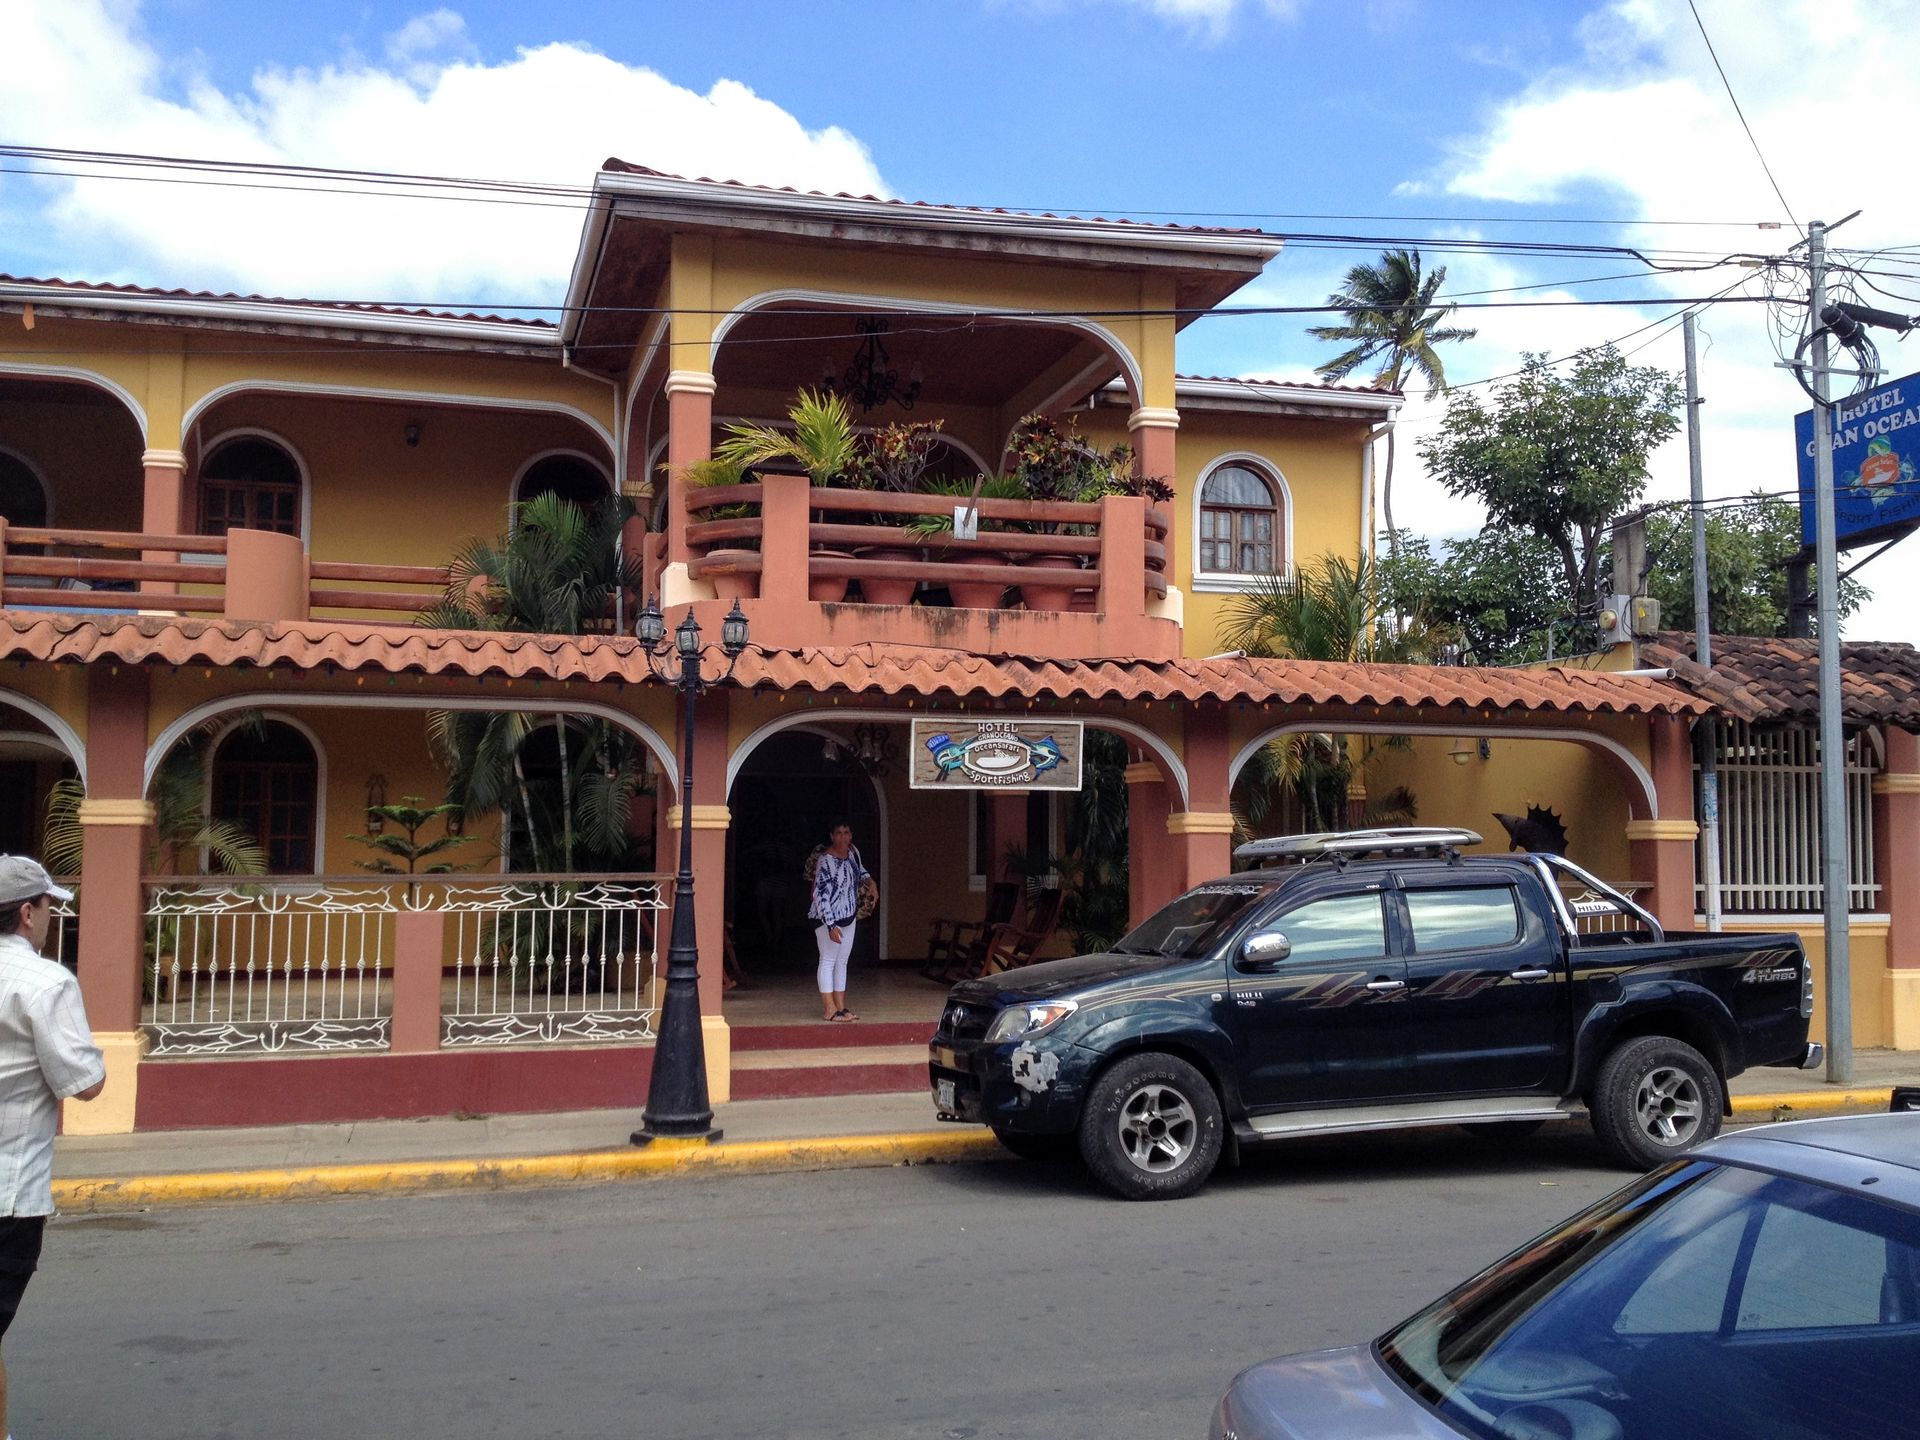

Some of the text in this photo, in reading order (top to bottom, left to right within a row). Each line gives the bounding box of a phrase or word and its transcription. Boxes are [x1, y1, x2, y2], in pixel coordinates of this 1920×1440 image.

[1842, 388, 1904, 423] HOTEL
[1806, 405, 1920, 458] GAN OCEA
[978, 723, 1018, 732] HOTEL
[1758, 972, 1797, 983] TURBO
